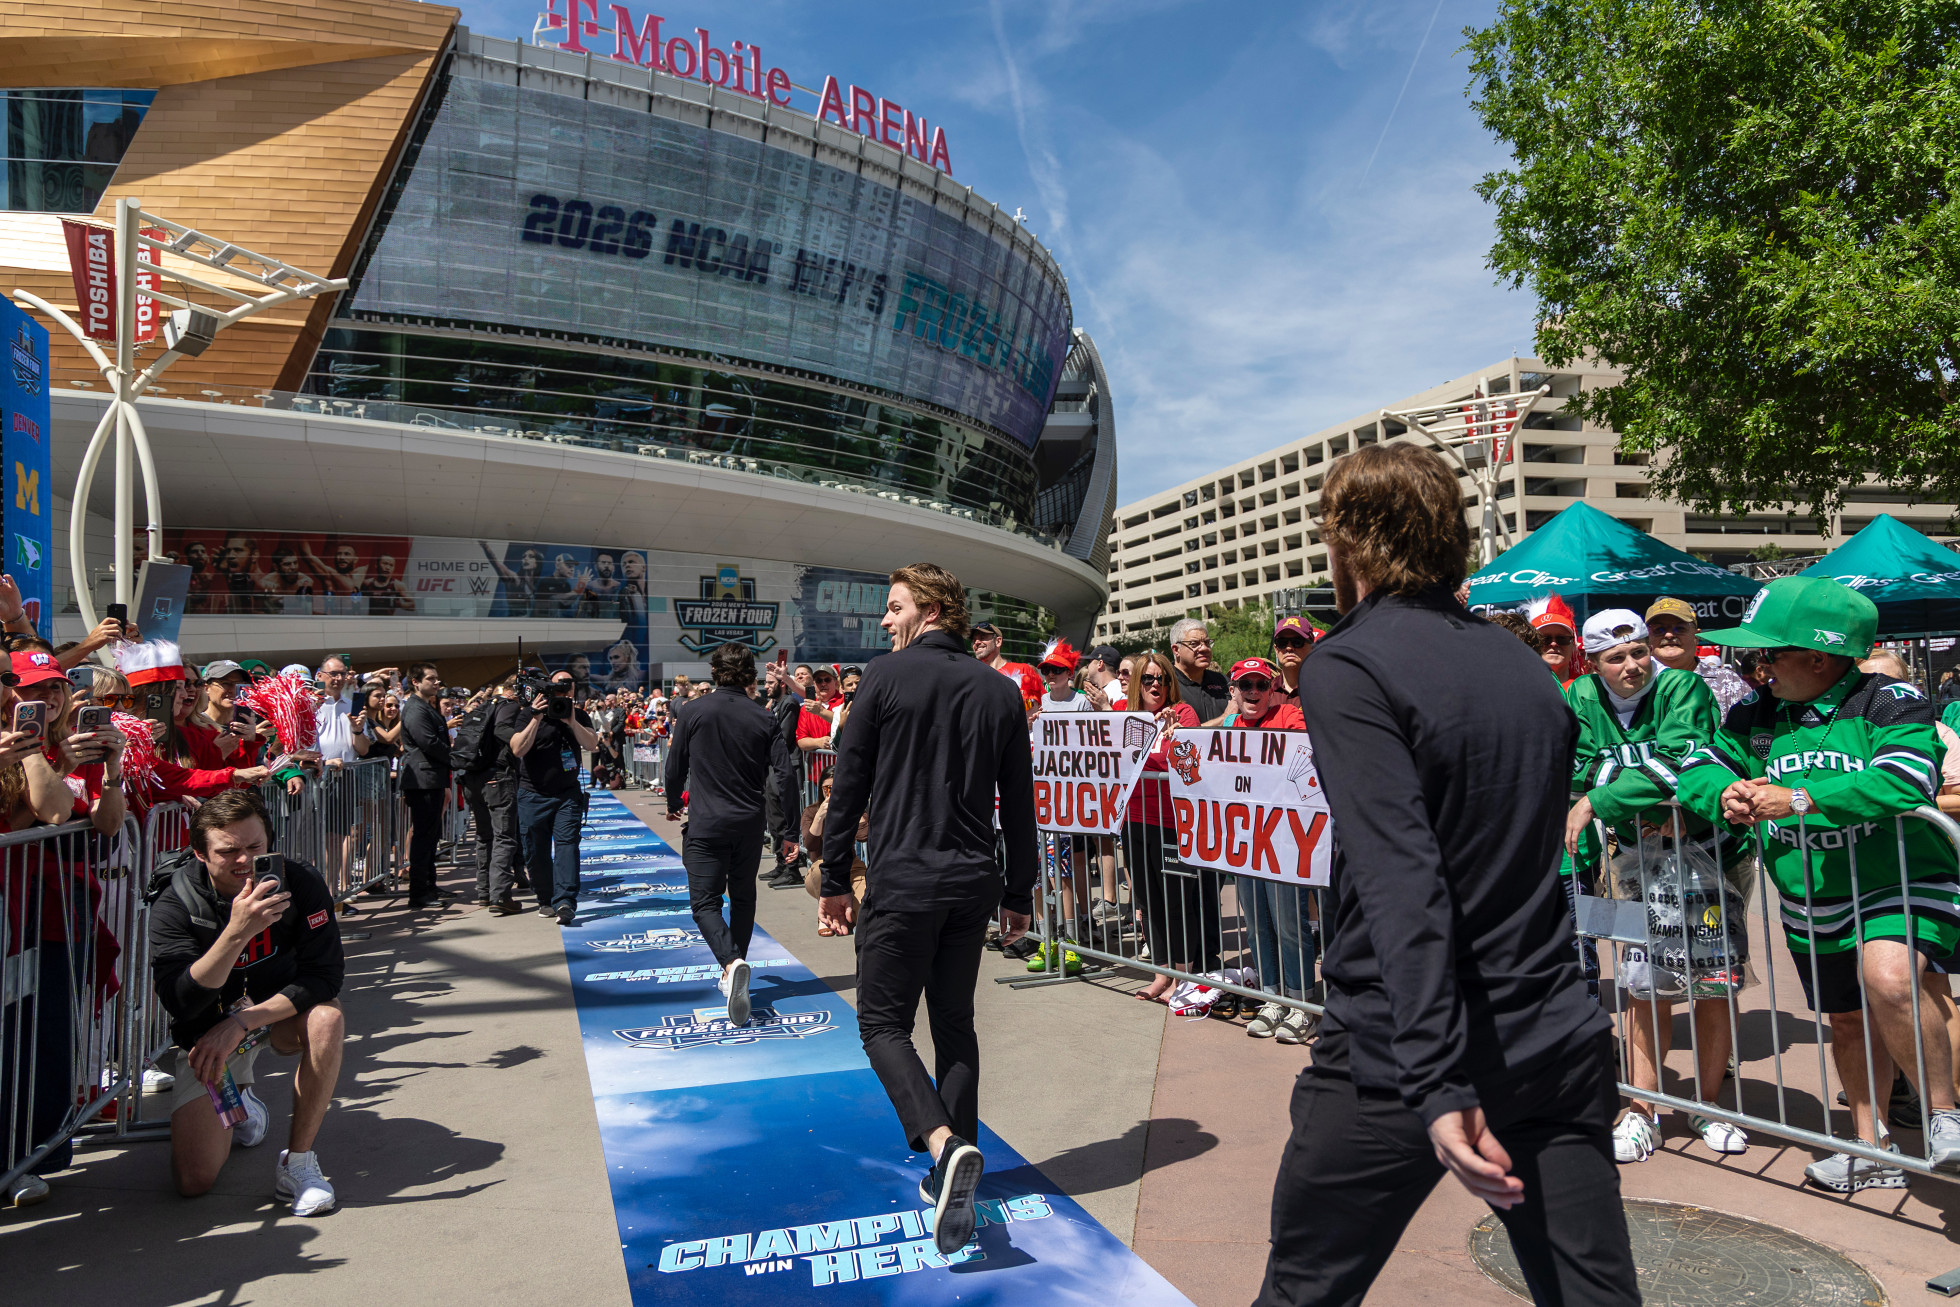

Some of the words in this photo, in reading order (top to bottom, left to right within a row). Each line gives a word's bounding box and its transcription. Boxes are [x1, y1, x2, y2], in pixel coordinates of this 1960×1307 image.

[816, 75, 953, 176] ARENA
[522, 194, 657, 260] 2026
[88, 233, 109, 333] TOSHIBA
[13, 412, 40, 445] DENVER
[15, 461, 40, 516] M
[418, 561, 464, 571] HOME
[469, 561, 490, 571] OF
[1509, 569, 1573, 588] Clips
[1591, 563, 1675, 582] Great
[1672, 561, 1734, 578] Clips
[416, 577, 456, 592] UFC
[685, 607, 737, 623] FROZEN
[739, 608, 773, 624] FOUR
[843, 616, 859, 628] WIN
[1043, 719, 1069, 746] HIT
[1075, 719, 1112, 747] THE
[1207, 731, 1250, 764] ALL
[1261, 732, 1287, 766] IN
[1034, 750, 1121, 779] JACKPOT
[1765, 750, 1865, 784] NORTH
[1235, 775, 1251, 793] ON
[1034, 780, 1128, 829] BUCK
[1173, 797, 1328, 879] BUCKY
[583, 958, 790, 981] CHAMPINS
[750, 1015, 816, 1029] FOUR
[657, 1193, 1054, 1274] CHAMPINS
[744, 1258, 793, 1276] WIN
[802, 1232, 988, 1287] HERE
